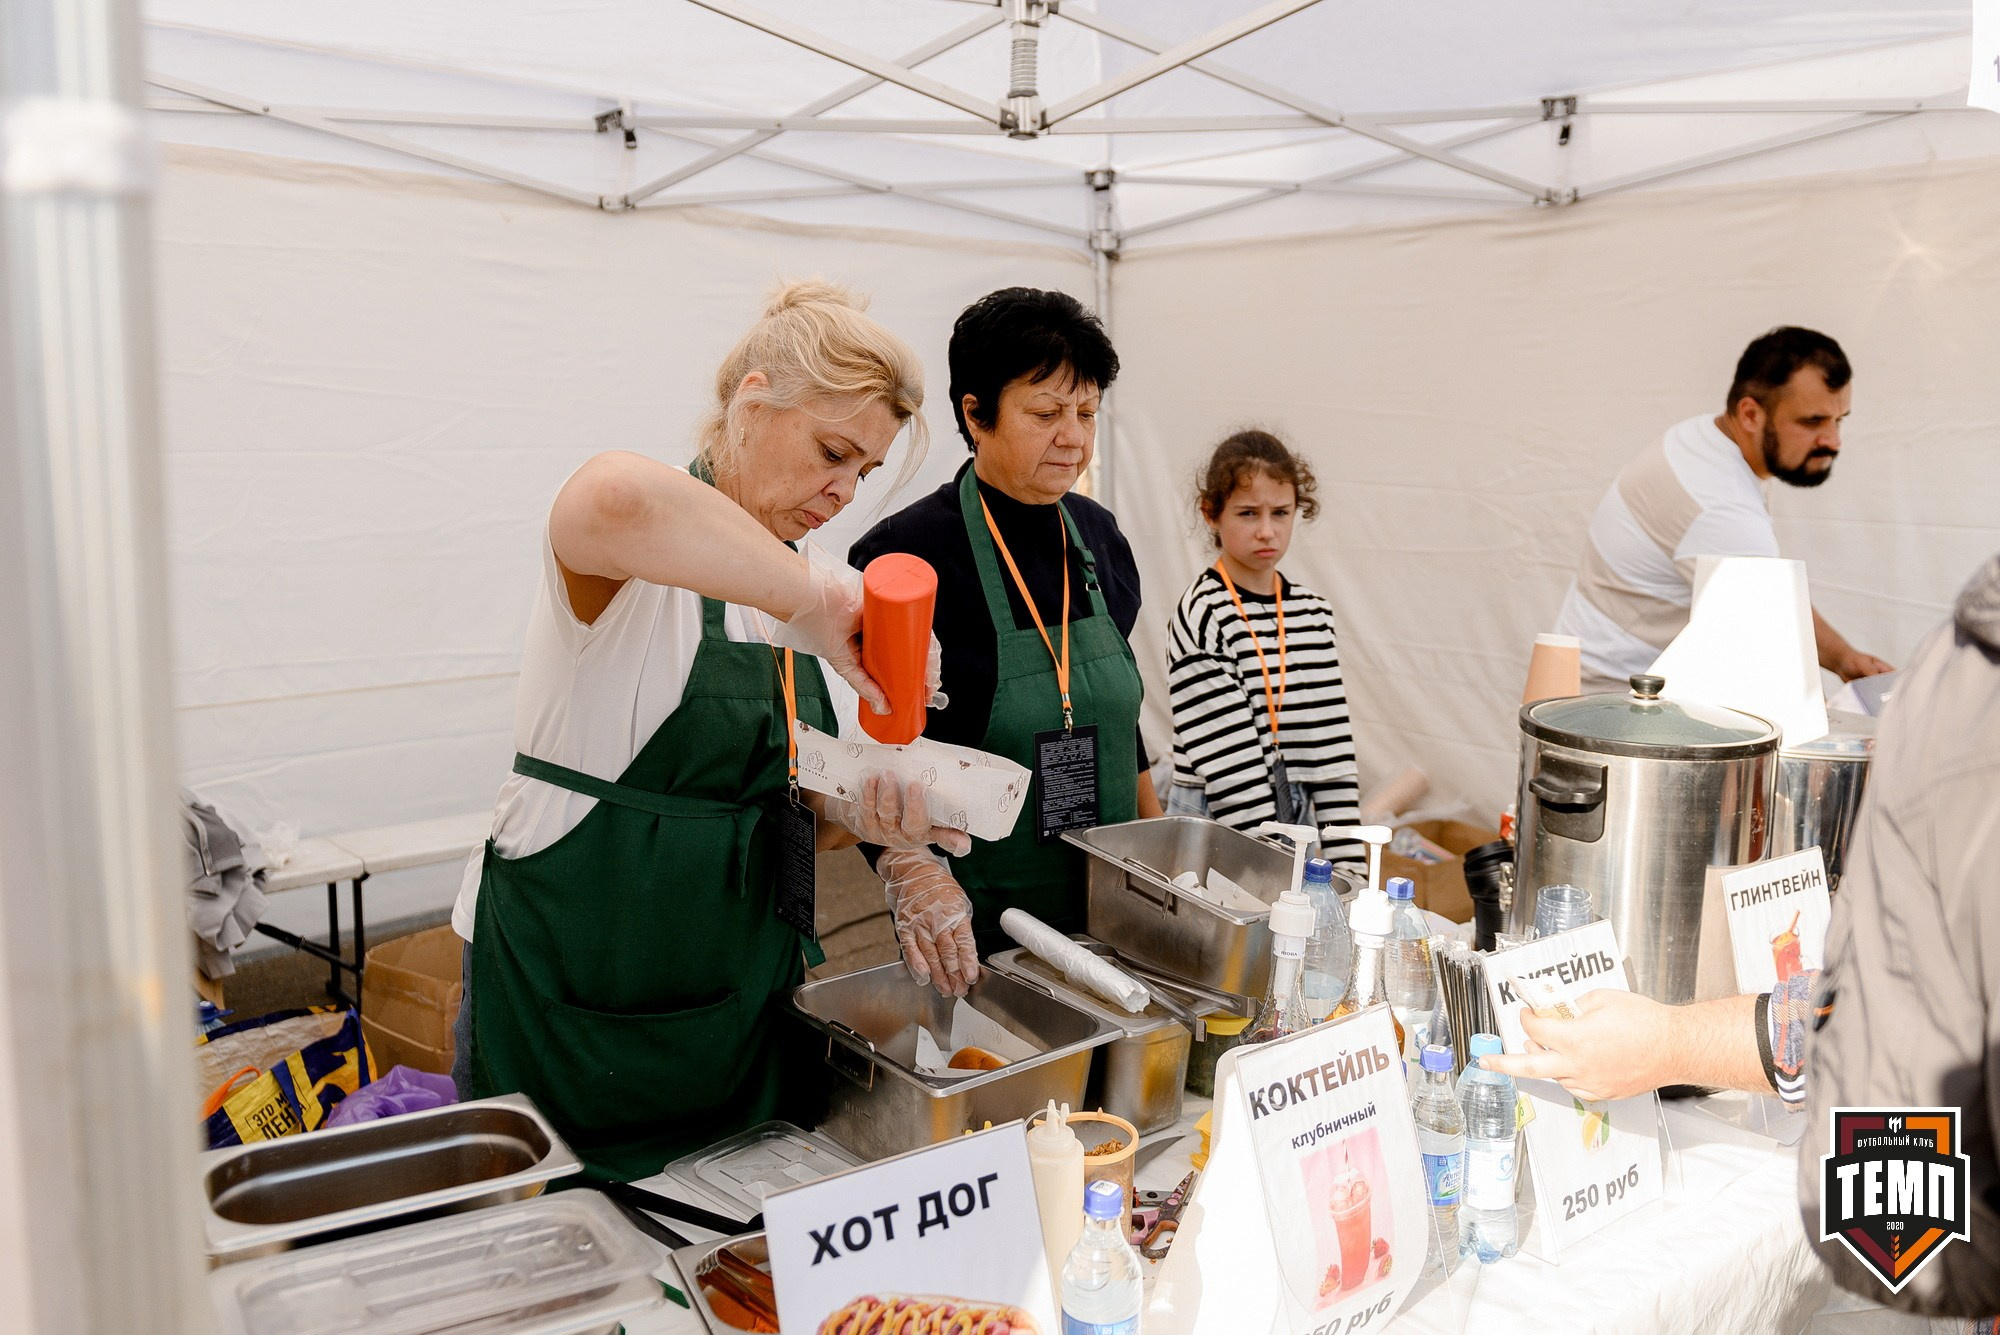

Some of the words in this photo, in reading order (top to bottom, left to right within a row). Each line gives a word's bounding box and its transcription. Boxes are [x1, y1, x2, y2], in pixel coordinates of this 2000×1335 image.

[1730, 869, 1822, 912] ГЛИНТВЕЙН
[1497, 950, 1615, 1006] КЕЙЛЬ
[1249, 1045, 1391, 1120] КОКТЕЙЛЬ
[1291, 1101, 1377, 1150] клубничный
[808, 1203, 899, 1266] ХОТ
[917, 1172, 999, 1238] ДОГ
[1562, 1183, 1599, 1222] 250
[1605, 1163, 1639, 1206] руб
[1345, 1290, 1395, 1335] руб
